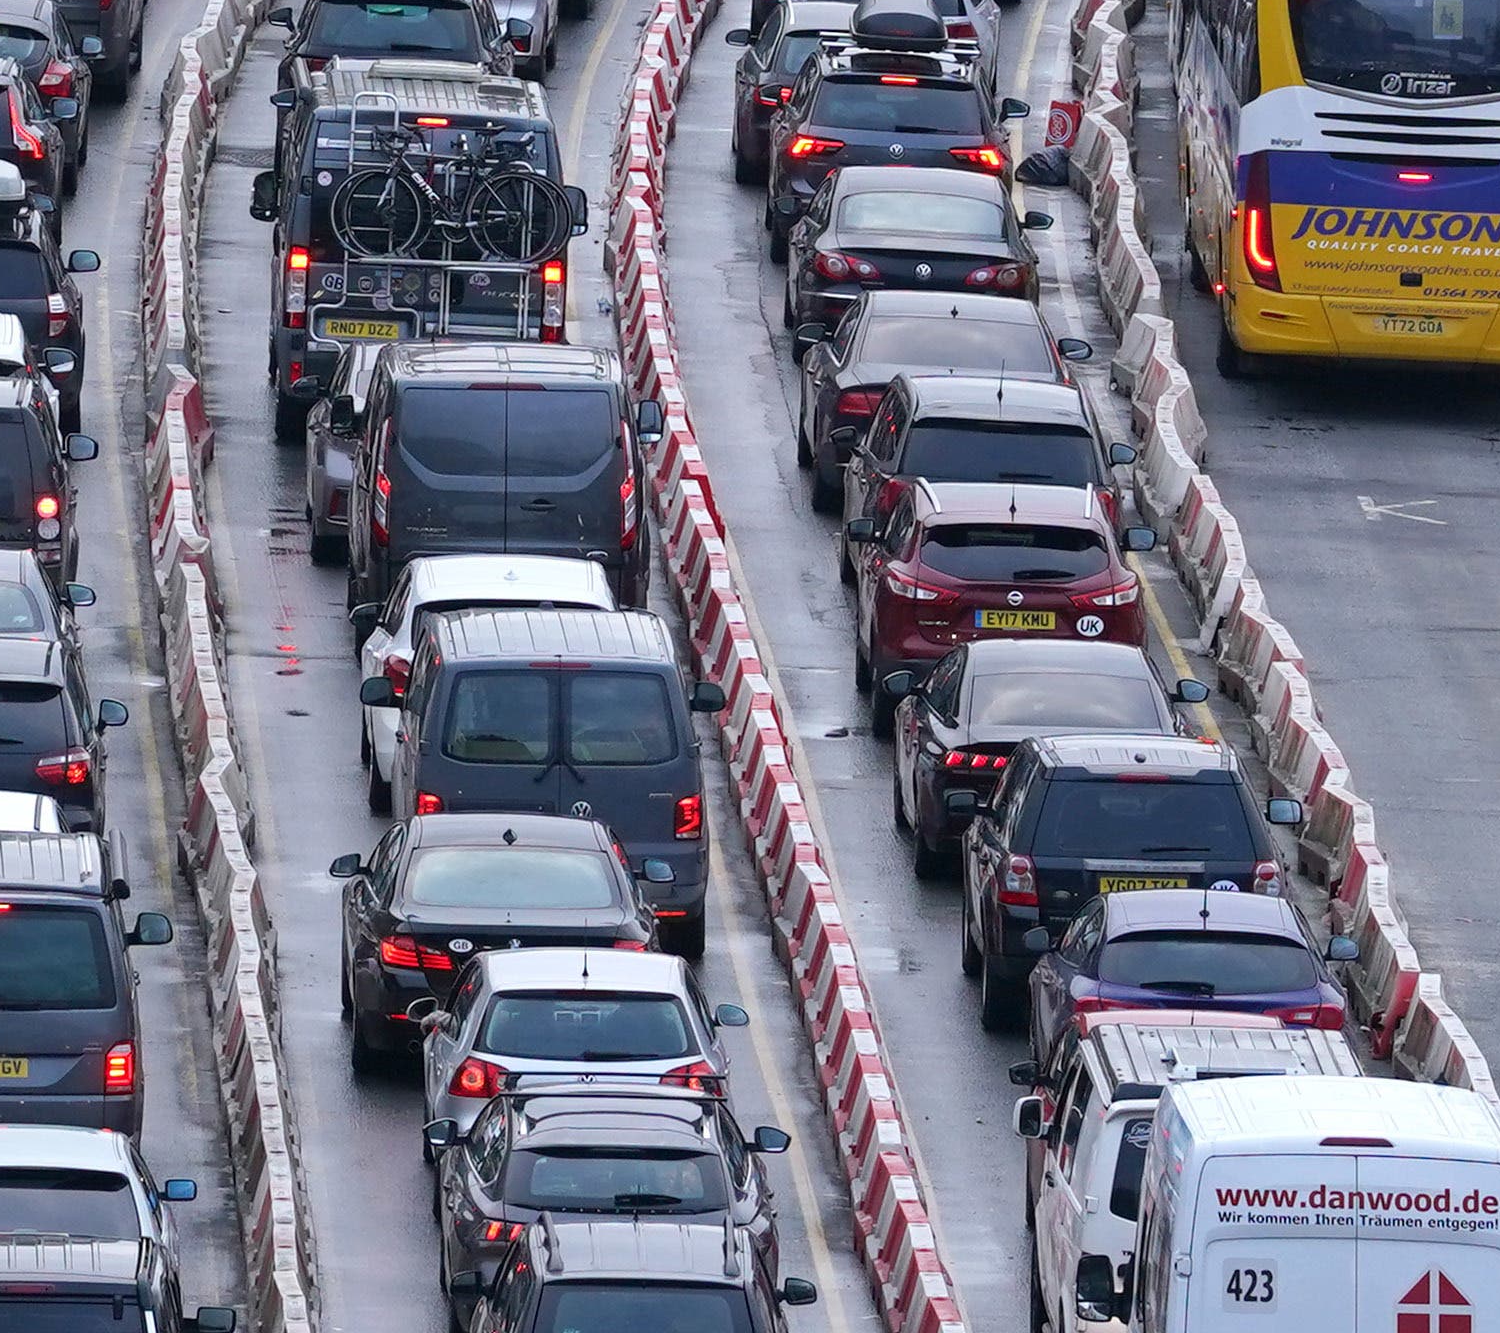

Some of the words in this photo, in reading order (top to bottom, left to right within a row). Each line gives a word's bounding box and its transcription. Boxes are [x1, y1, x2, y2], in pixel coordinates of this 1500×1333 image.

[1306, 239, 1379, 253] QUALITY
[1386, 242, 1443, 256] COACH
[325, 273, 345, 291] GB
[1423, 286, 1467, 299] 01564
[329, 321, 364, 335] RN07
[1381, 318, 1415, 333] YT72
[986, 612, 1019, 627] EY17
[1021, 614, 1050, 628] KMU
[1080, 618, 1100, 633] UK
[453, 941, 470, 951] GB
[1215, 1184, 1500, 1215] www.danwood.de
[1217, 1211, 1243, 1225] Wir
[1246, 1211, 1310, 1226] kommen
[1314, 1213, 1355, 1227] Ihren
[1358, 1213, 1423, 1228] Träumen
[1427, 1216, 1500, 1234] entgegen!
[1226, 1268, 1275, 1303] 423
